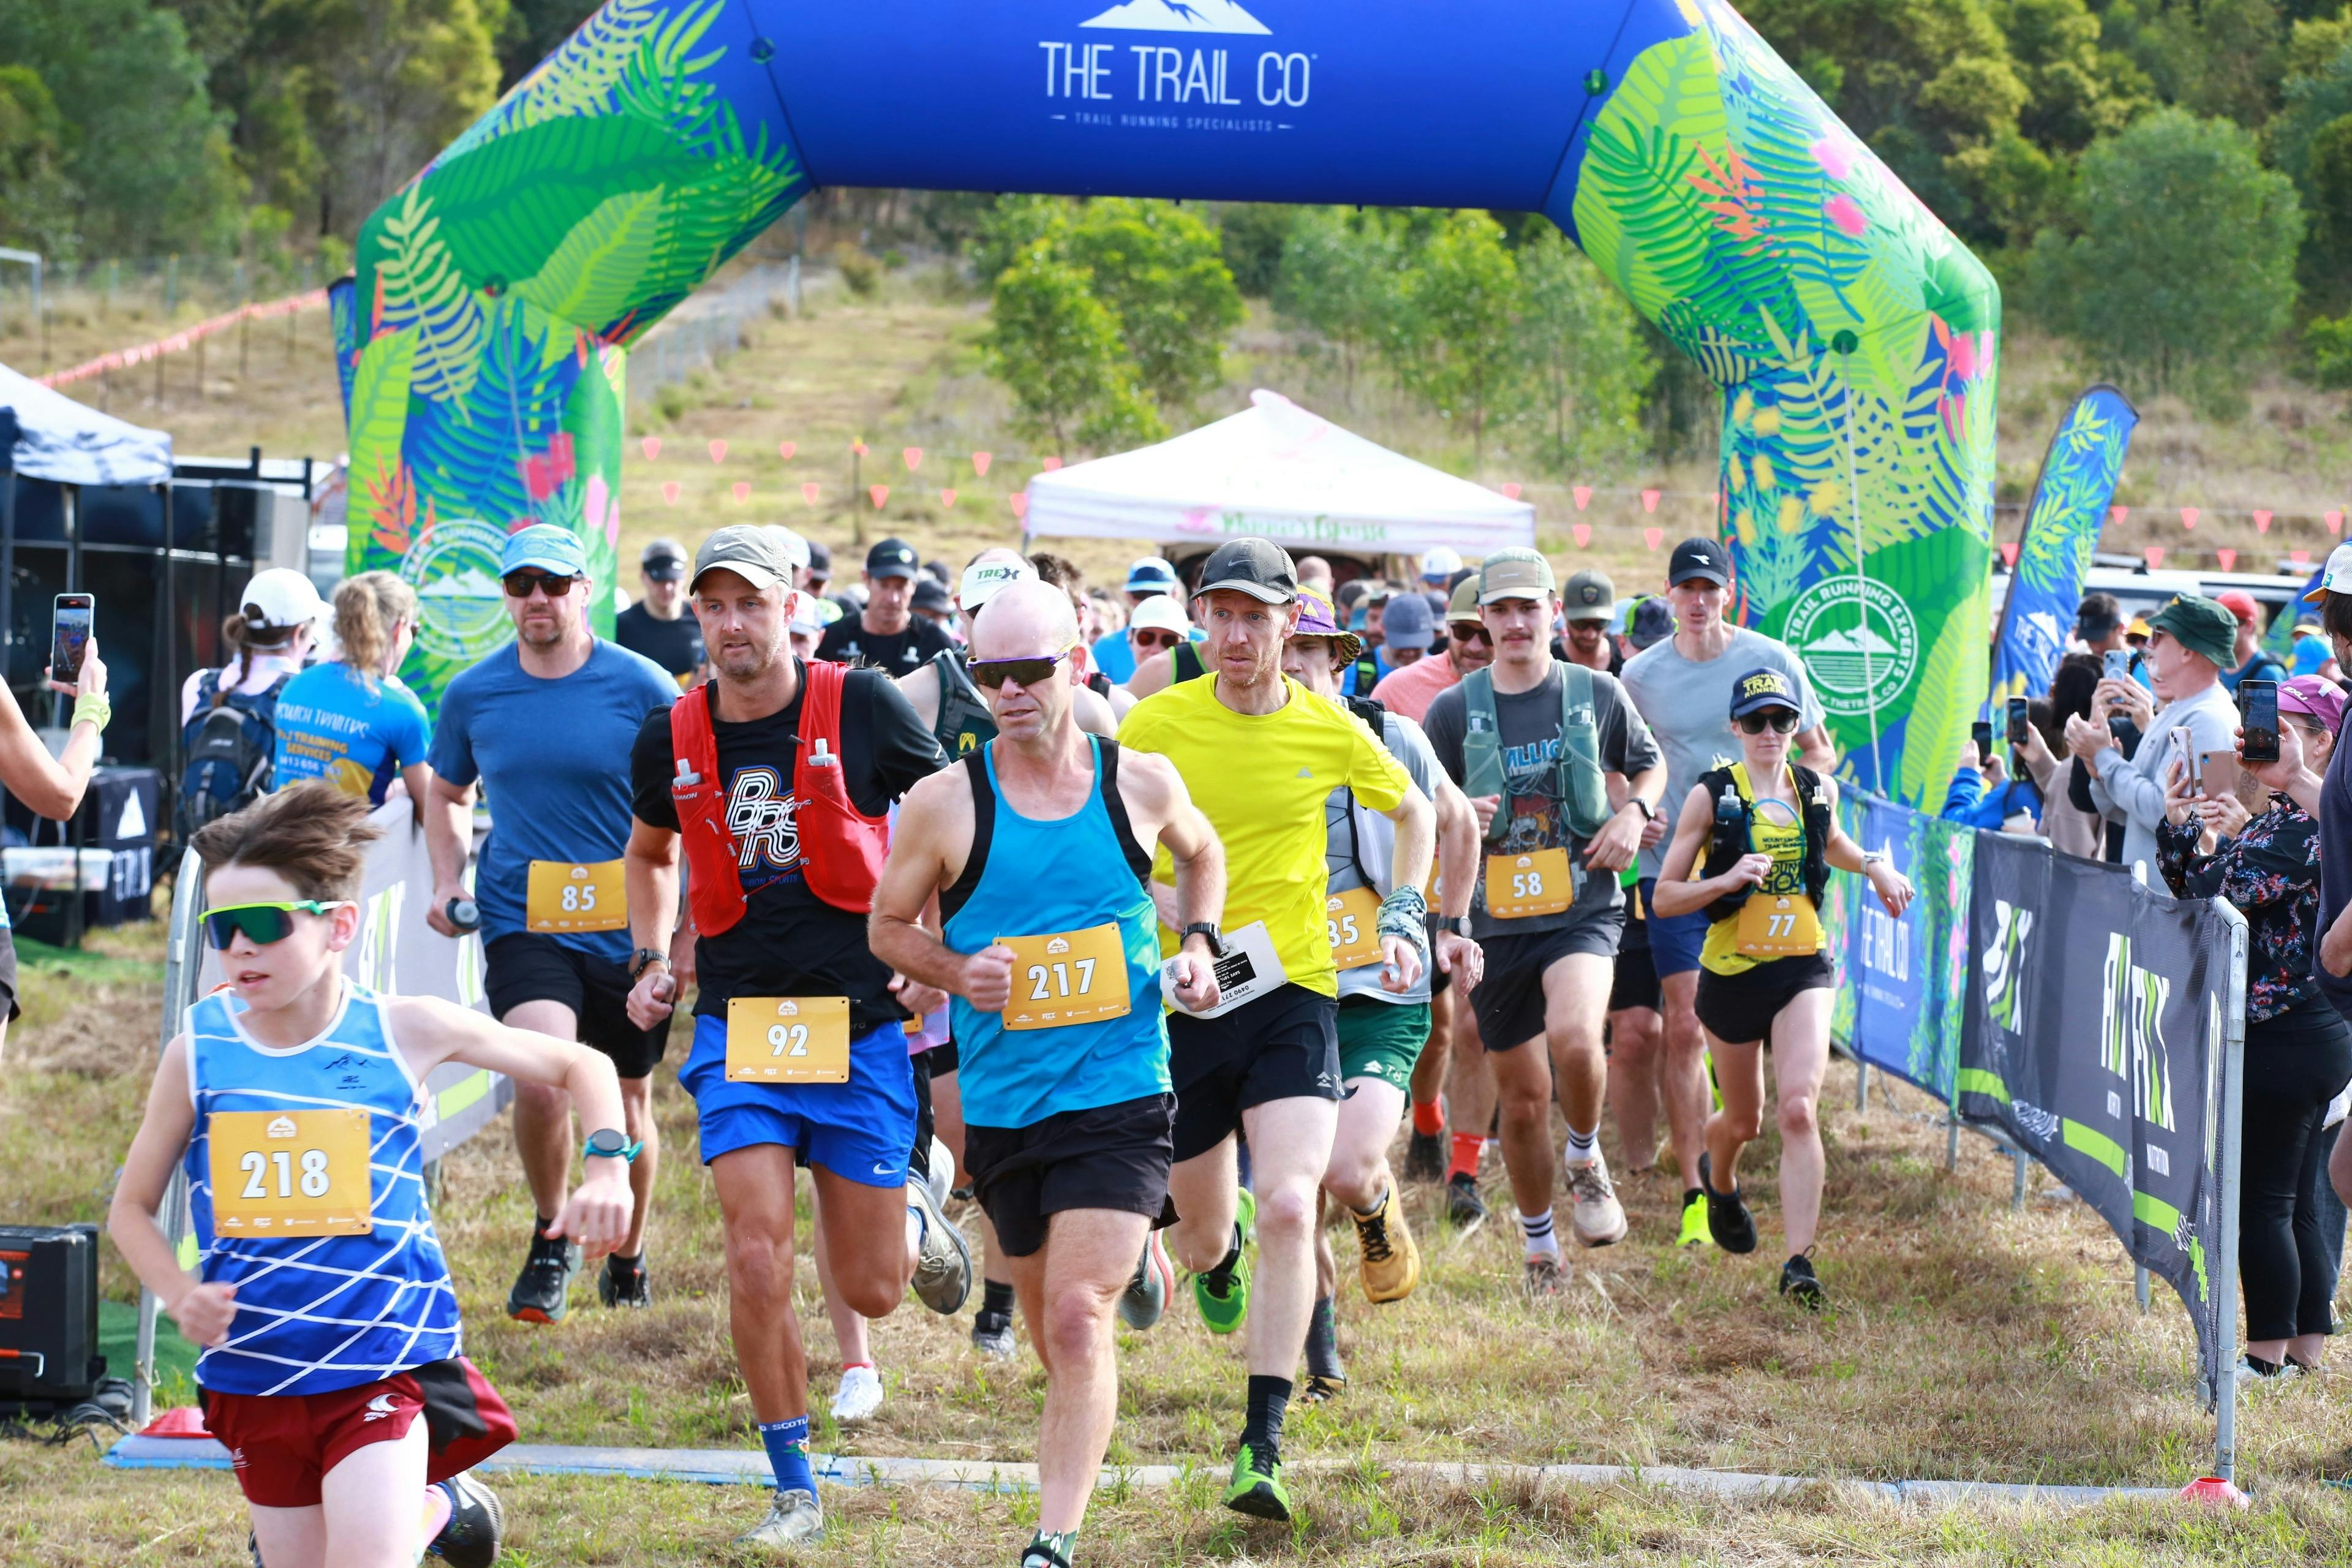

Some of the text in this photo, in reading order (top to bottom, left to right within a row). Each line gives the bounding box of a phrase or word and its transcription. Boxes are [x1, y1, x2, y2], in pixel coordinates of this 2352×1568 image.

[1038, 41, 1310, 107] THE TRAIL CO
[1075, 111, 1273, 132] TRAIL RUNNING SPECIALISTS
[1789, 582, 1912, 678] TRAIL RUNNING EXPERTS
[2283, 686, 2309, 701] 2XU
[561, 884, 596, 912] 85
[1513, 872, 1543, 898] 58
[1767, 914, 1796, 938] 77
[1027, 957, 1096, 1000] 217
[1222, 985, 1250, 1001] 0490 271
[767, 1023, 809, 1057] 92
[239, 1148, 330, 1199] 218
